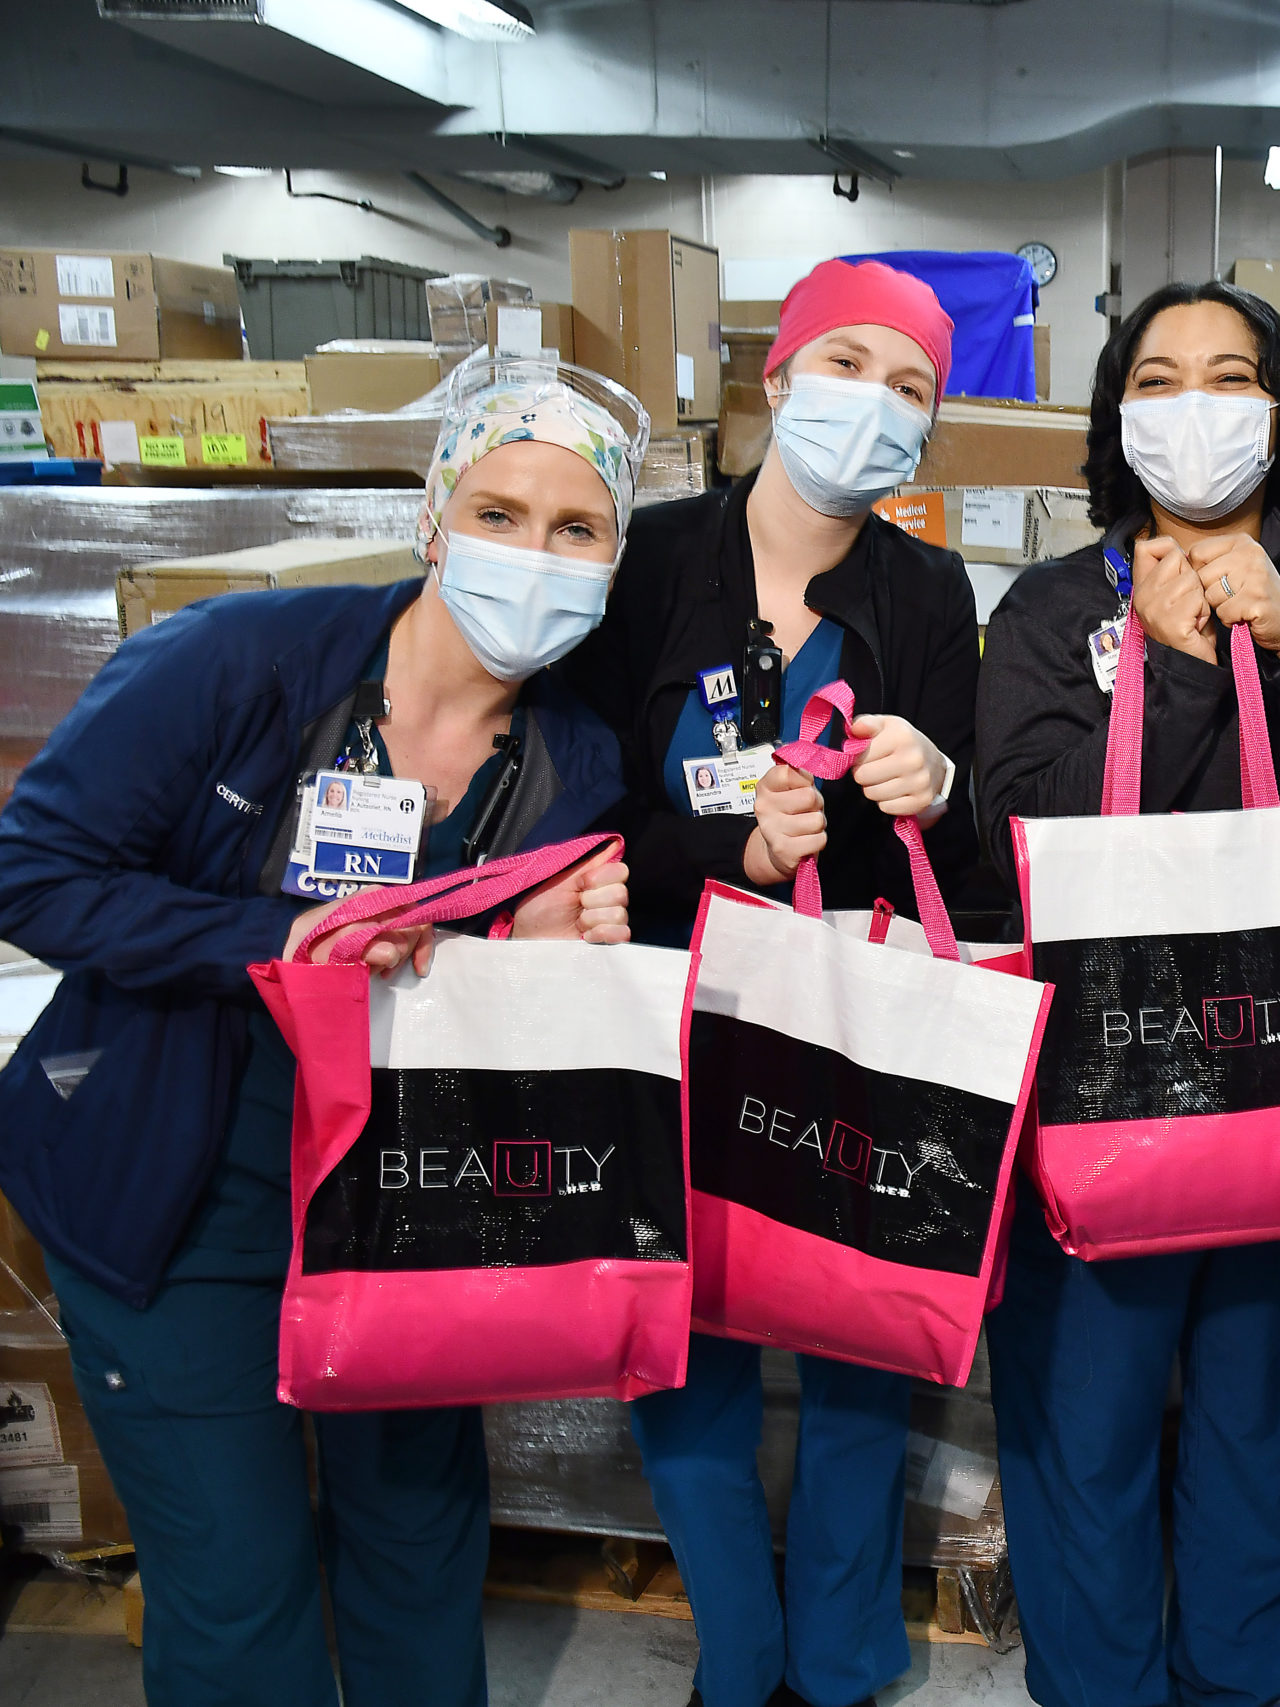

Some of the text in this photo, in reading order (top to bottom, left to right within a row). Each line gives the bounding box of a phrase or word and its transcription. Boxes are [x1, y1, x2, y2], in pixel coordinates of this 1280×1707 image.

[895, 503, 928, 519] Medical
[897, 518, 926, 531] Service
[361, 830, 412, 845] Methodist
[343, 850, 382, 875] RN
[297, 869, 366, 899] CCR
[738, 1095, 929, 1190] BEAUTY
[379, 1143, 616, 1190] BEAUTY
